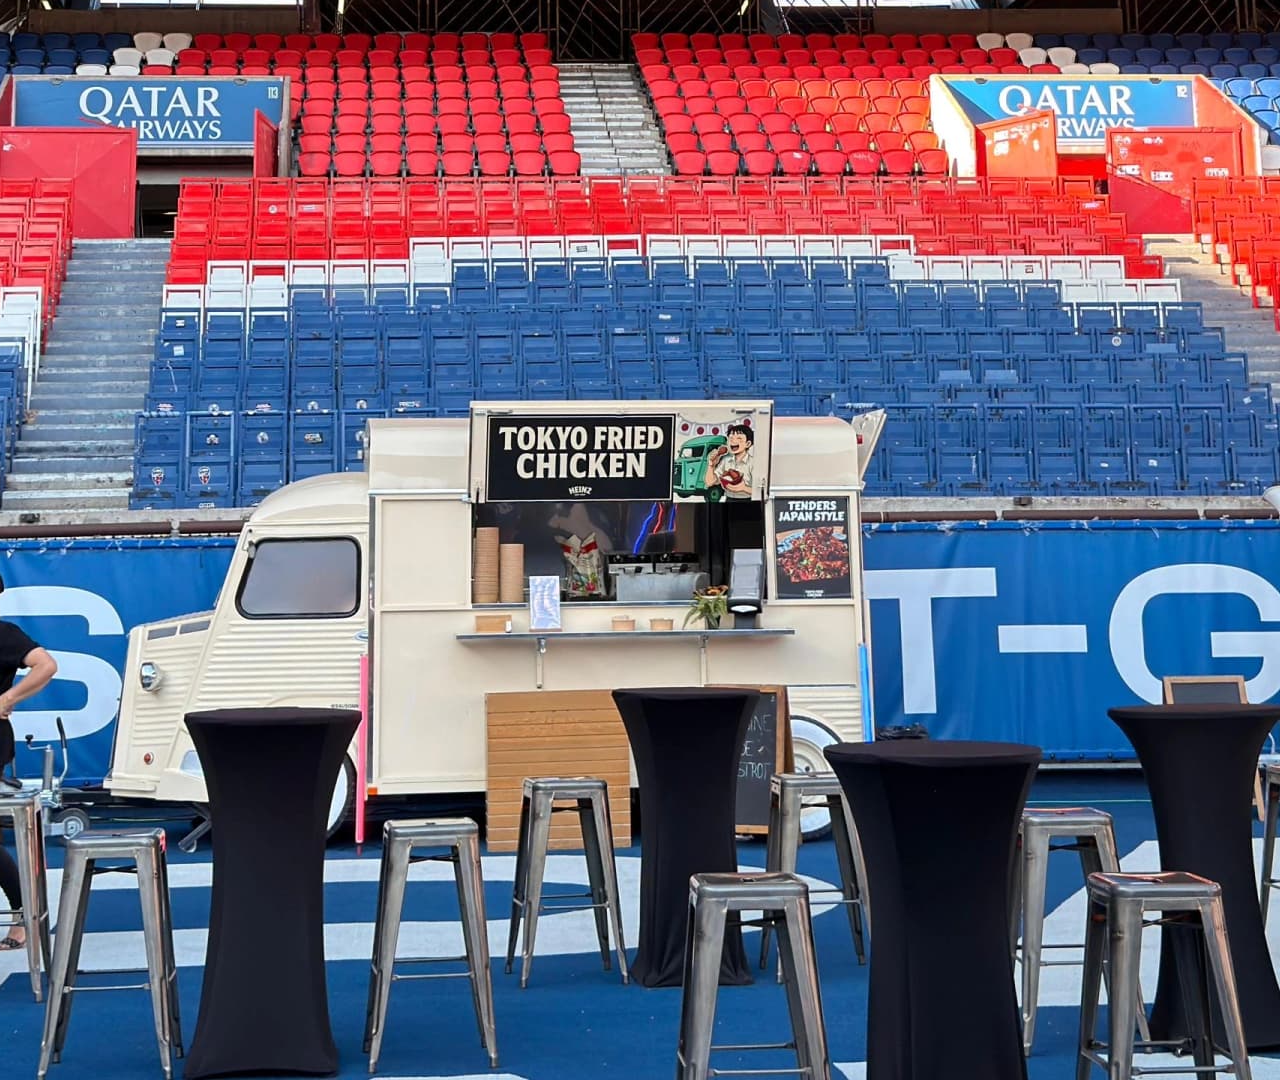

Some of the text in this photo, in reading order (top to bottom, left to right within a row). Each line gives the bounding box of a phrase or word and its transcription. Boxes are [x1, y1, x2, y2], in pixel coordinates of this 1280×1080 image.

[79, 86, 221, 124] QATAR
[999, 84, 1134, 117] QATAR
[499, 425, 664, 451] TOKYO FRIED
[516, 452, 647, 479] CHICKEN
[568, 485, 593, 495] HEINZ
[779, 511, 845, 522] JAPAN STYLE
[788, 500, 837, 511] TENDERS
